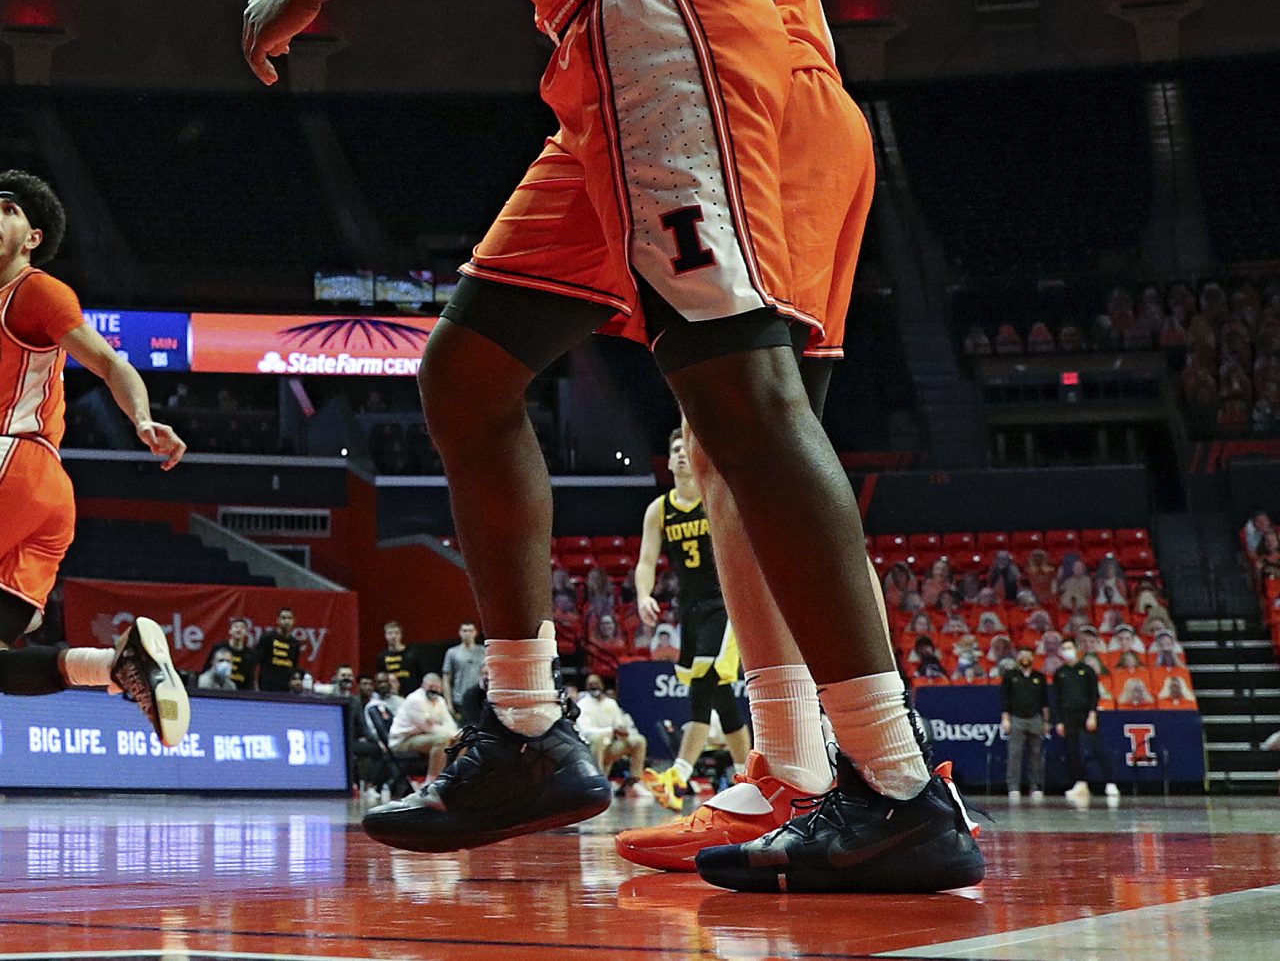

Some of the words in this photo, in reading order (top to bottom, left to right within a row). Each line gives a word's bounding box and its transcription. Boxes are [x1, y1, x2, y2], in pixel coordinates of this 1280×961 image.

[665, 518, 711, 543] IOWA
[682, 539, 701, 569] 3
[29, 726, 62, 753] BIG
[66, 729, 107, 755] LIFE.
[117, 730, 148, 756] BIG
[213, 735, 244, 761] BIG
